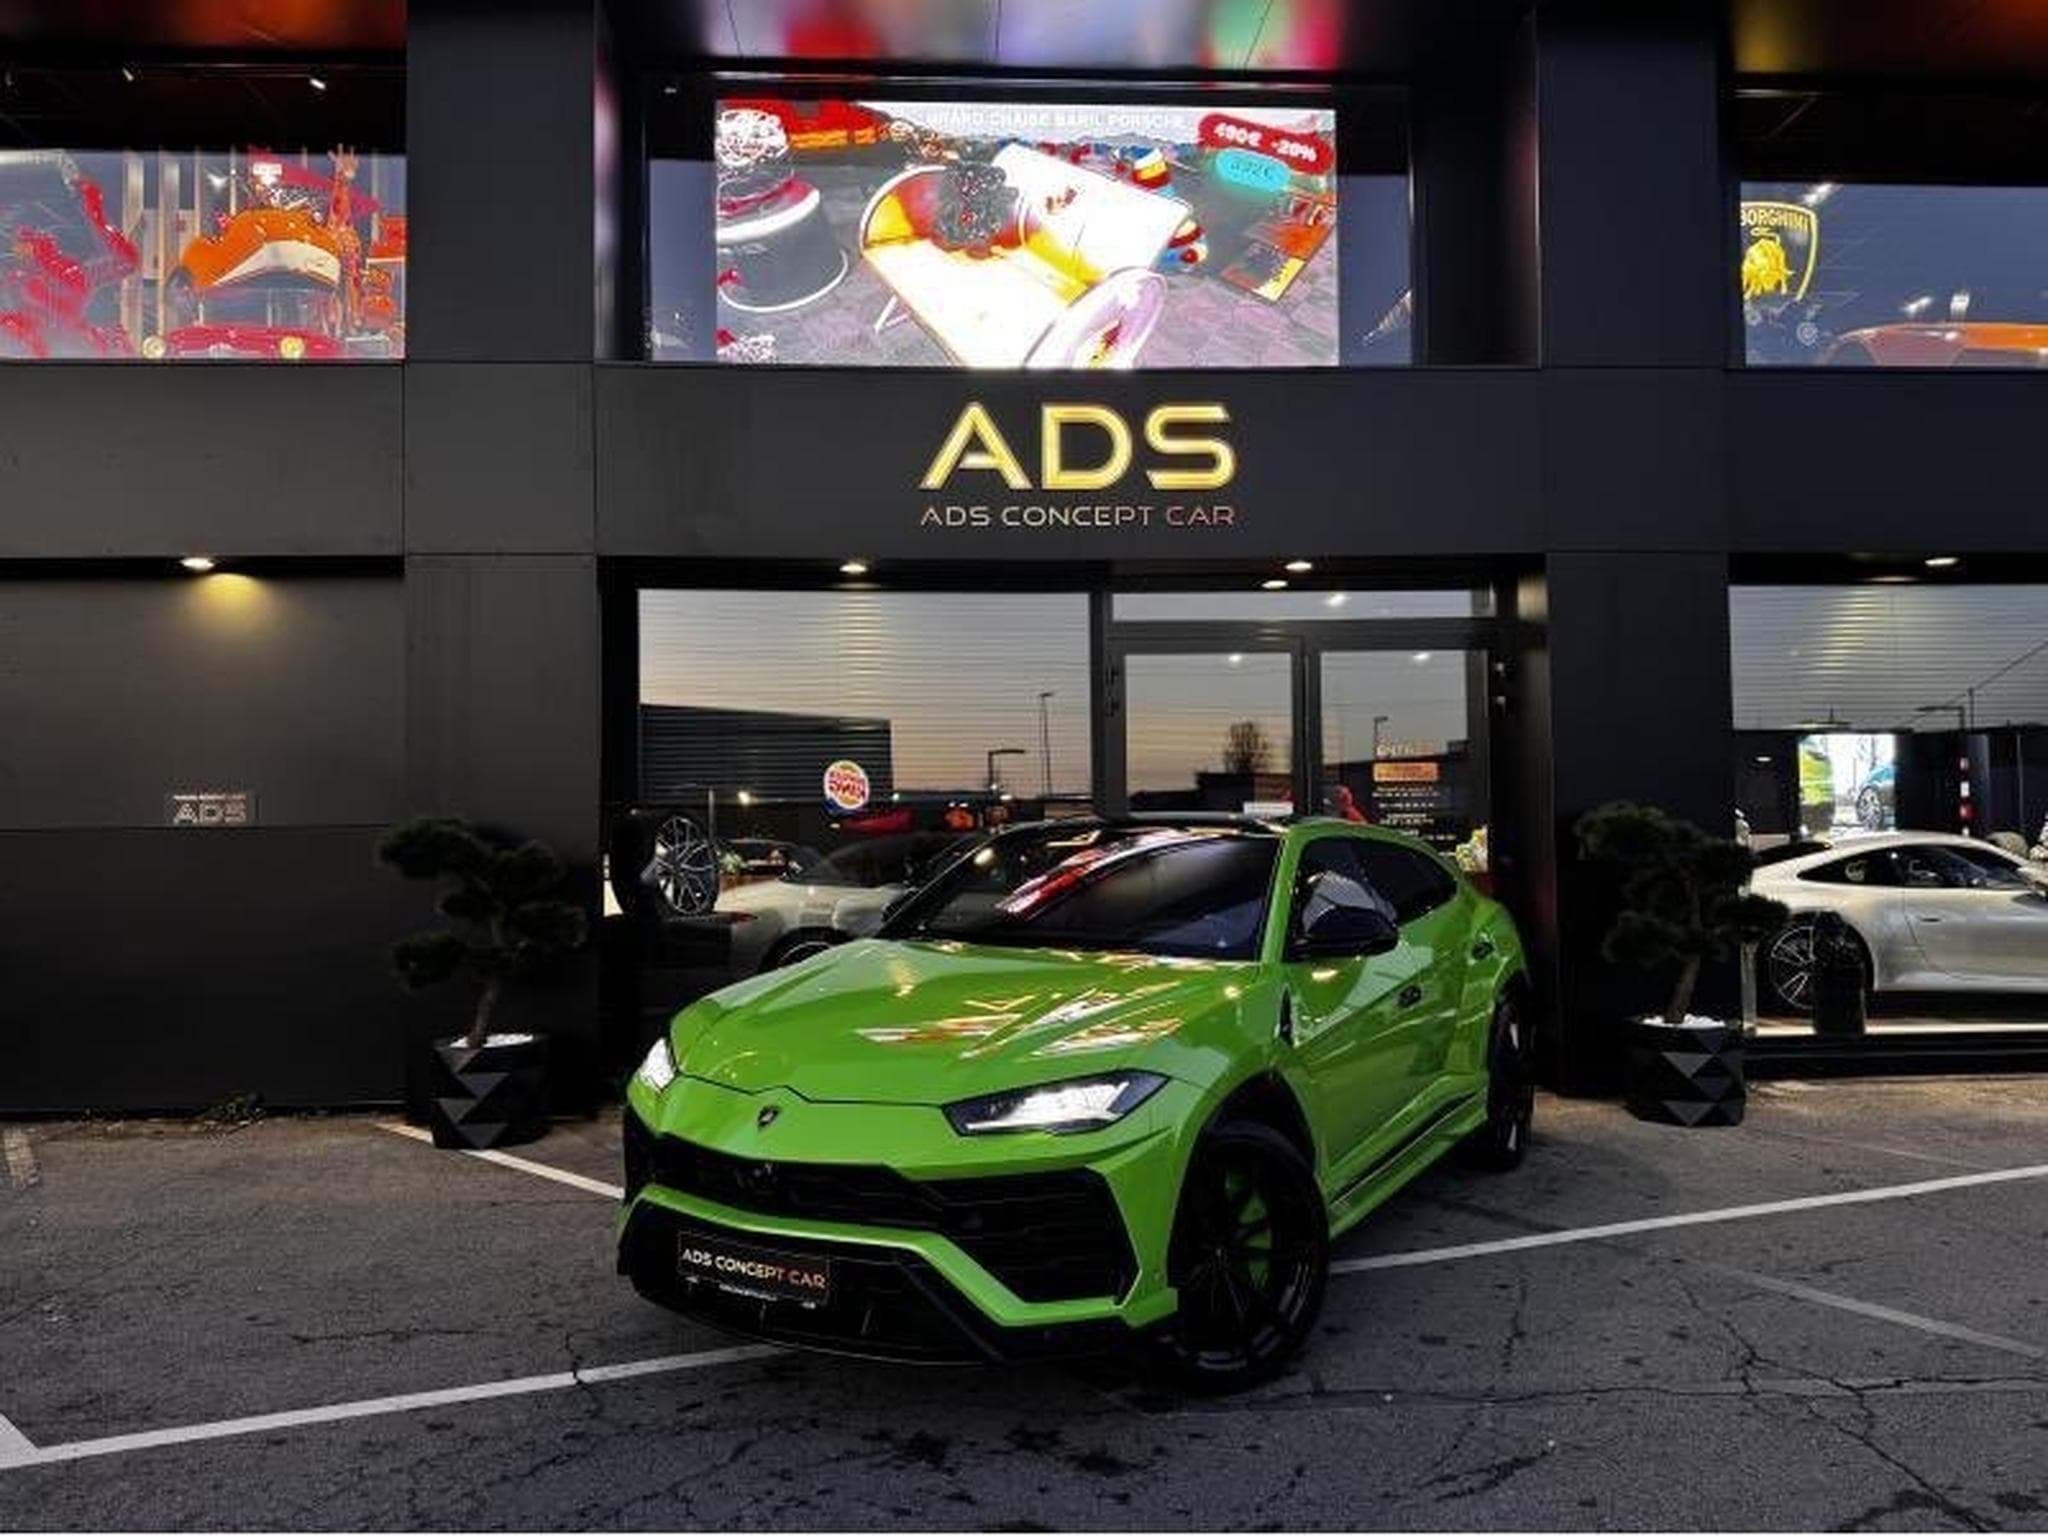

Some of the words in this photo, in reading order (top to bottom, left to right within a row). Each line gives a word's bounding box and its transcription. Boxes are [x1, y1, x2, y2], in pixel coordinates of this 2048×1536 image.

[918, 401, 1236, 490] ADS
[921, 506, 991, 527] ADS
[1001, 506, 1155, 527] CONCEPT
[1165, 506, 1236, 527] CAR
[682, 1248, 713, 1267] ADS
[714, 1255, 787, 1282] CONCEPT
[787, 1269, 826, 1290] CAR
